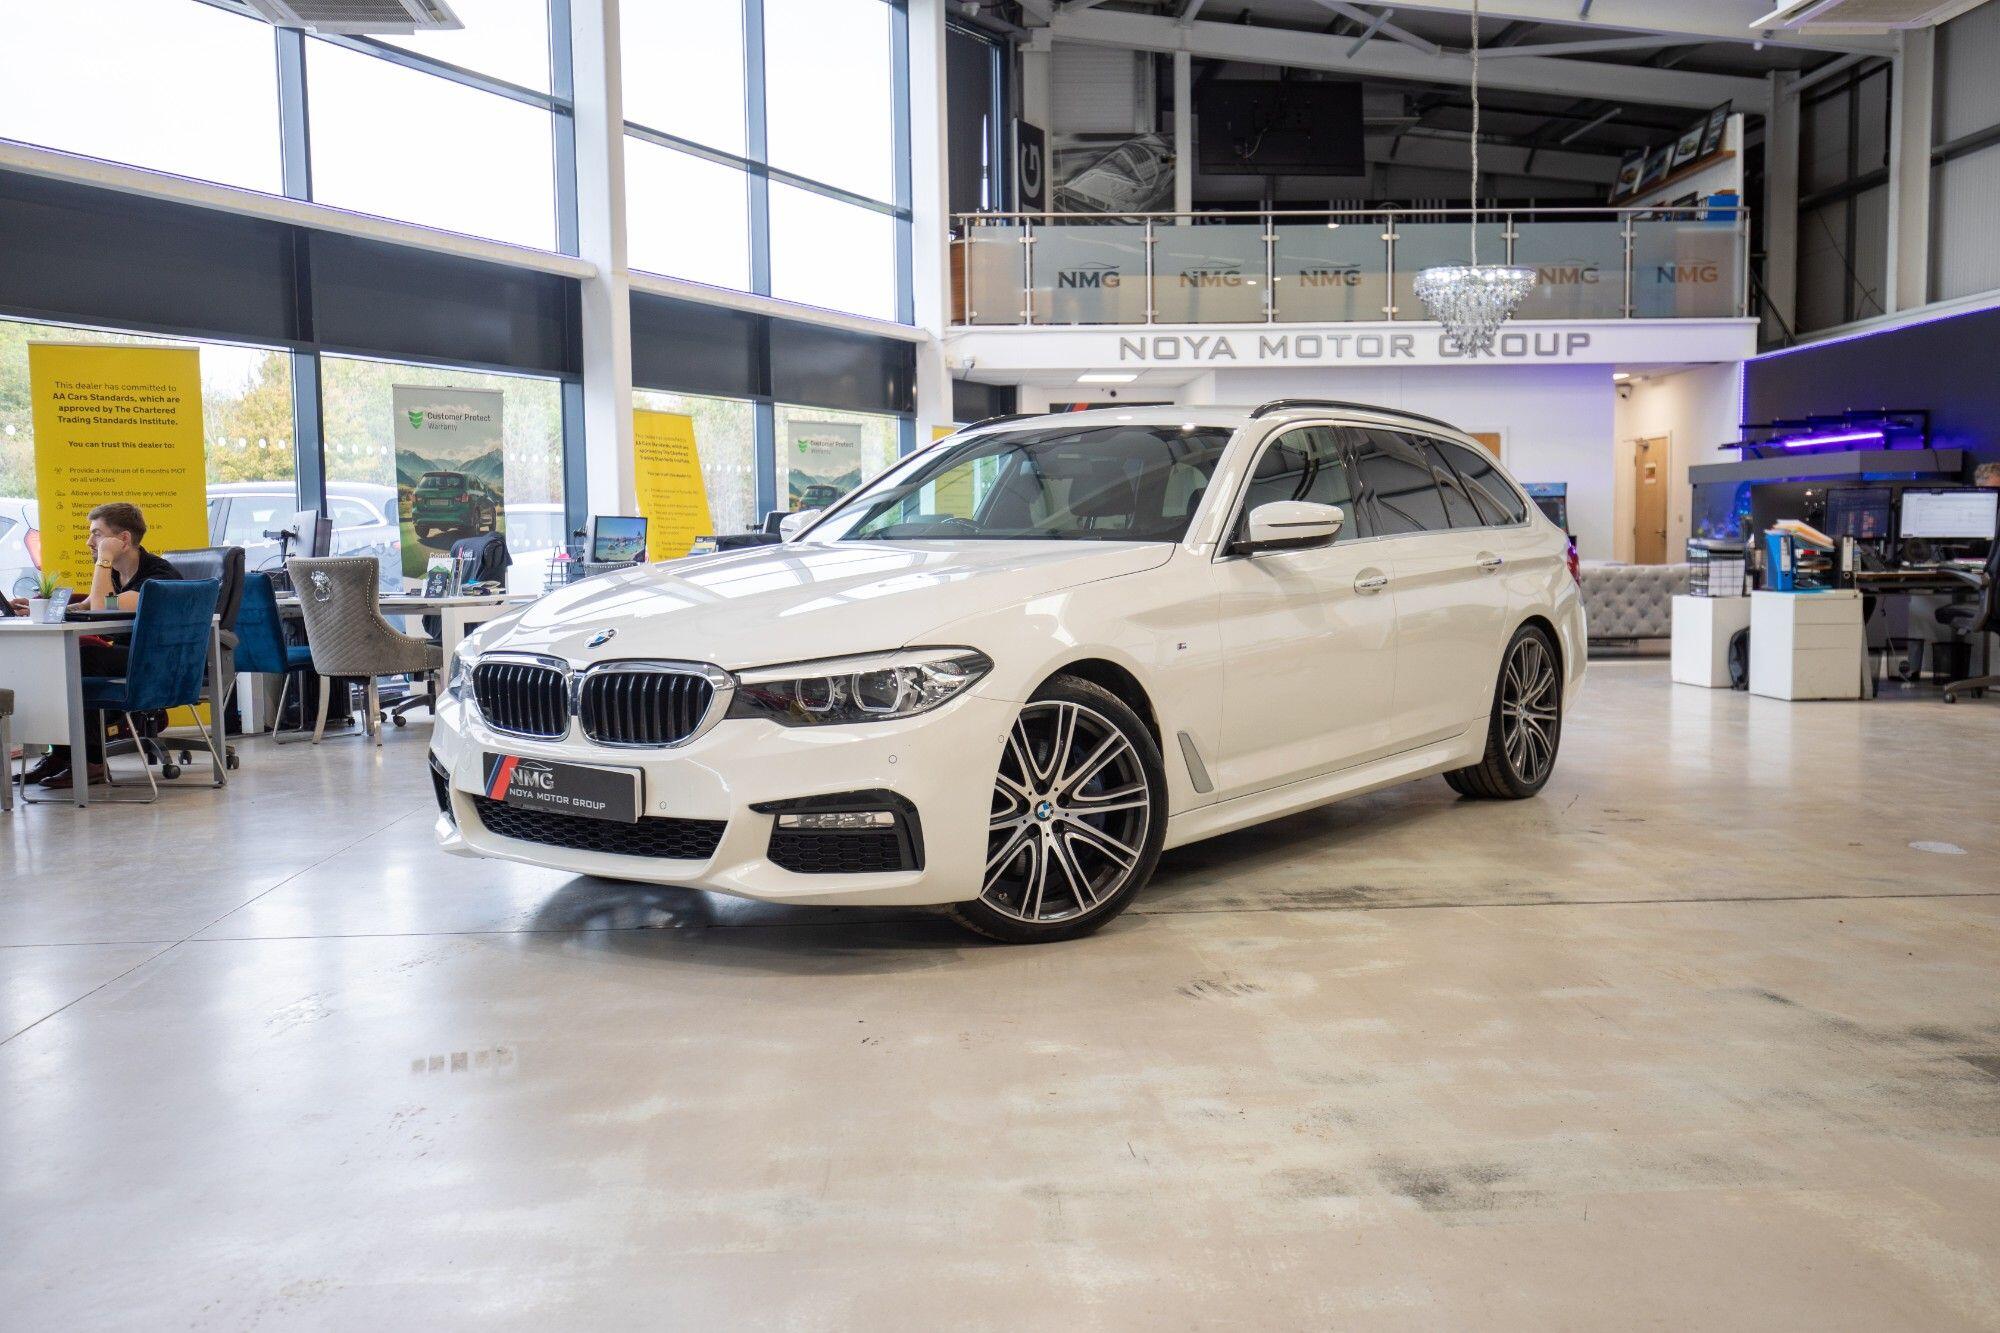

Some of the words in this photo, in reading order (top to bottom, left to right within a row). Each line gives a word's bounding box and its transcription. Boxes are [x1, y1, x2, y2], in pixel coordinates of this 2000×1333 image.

[1058, 271, 1120, 288] NMG
[1180, 270, 1242, 288] NMG
[1299, 270, 1361, 287] NMG
[1538, 267, 1599, 285] NMG
[1657, 266, 1718, 283] NMG
[1119, 335, 1237, 360] NOYA
[1259, 334, 1415, 359] MOTOR
[1438, 333, 1591, 357] GROUP
[76, 382, 101, 390] dealer
[91, 394, 137, 402] Standards,
[58, 416, 91, 424] Trading
[427, 412, 462, 421] Customer
[464, 413, 491, 422] Protect
[509, 767, 554, 790] NMG
[509, 788, 534, 799] NOYA
[536, 792, 570, 804] MOTOR
[572, 798, 606, 810] GROUP
